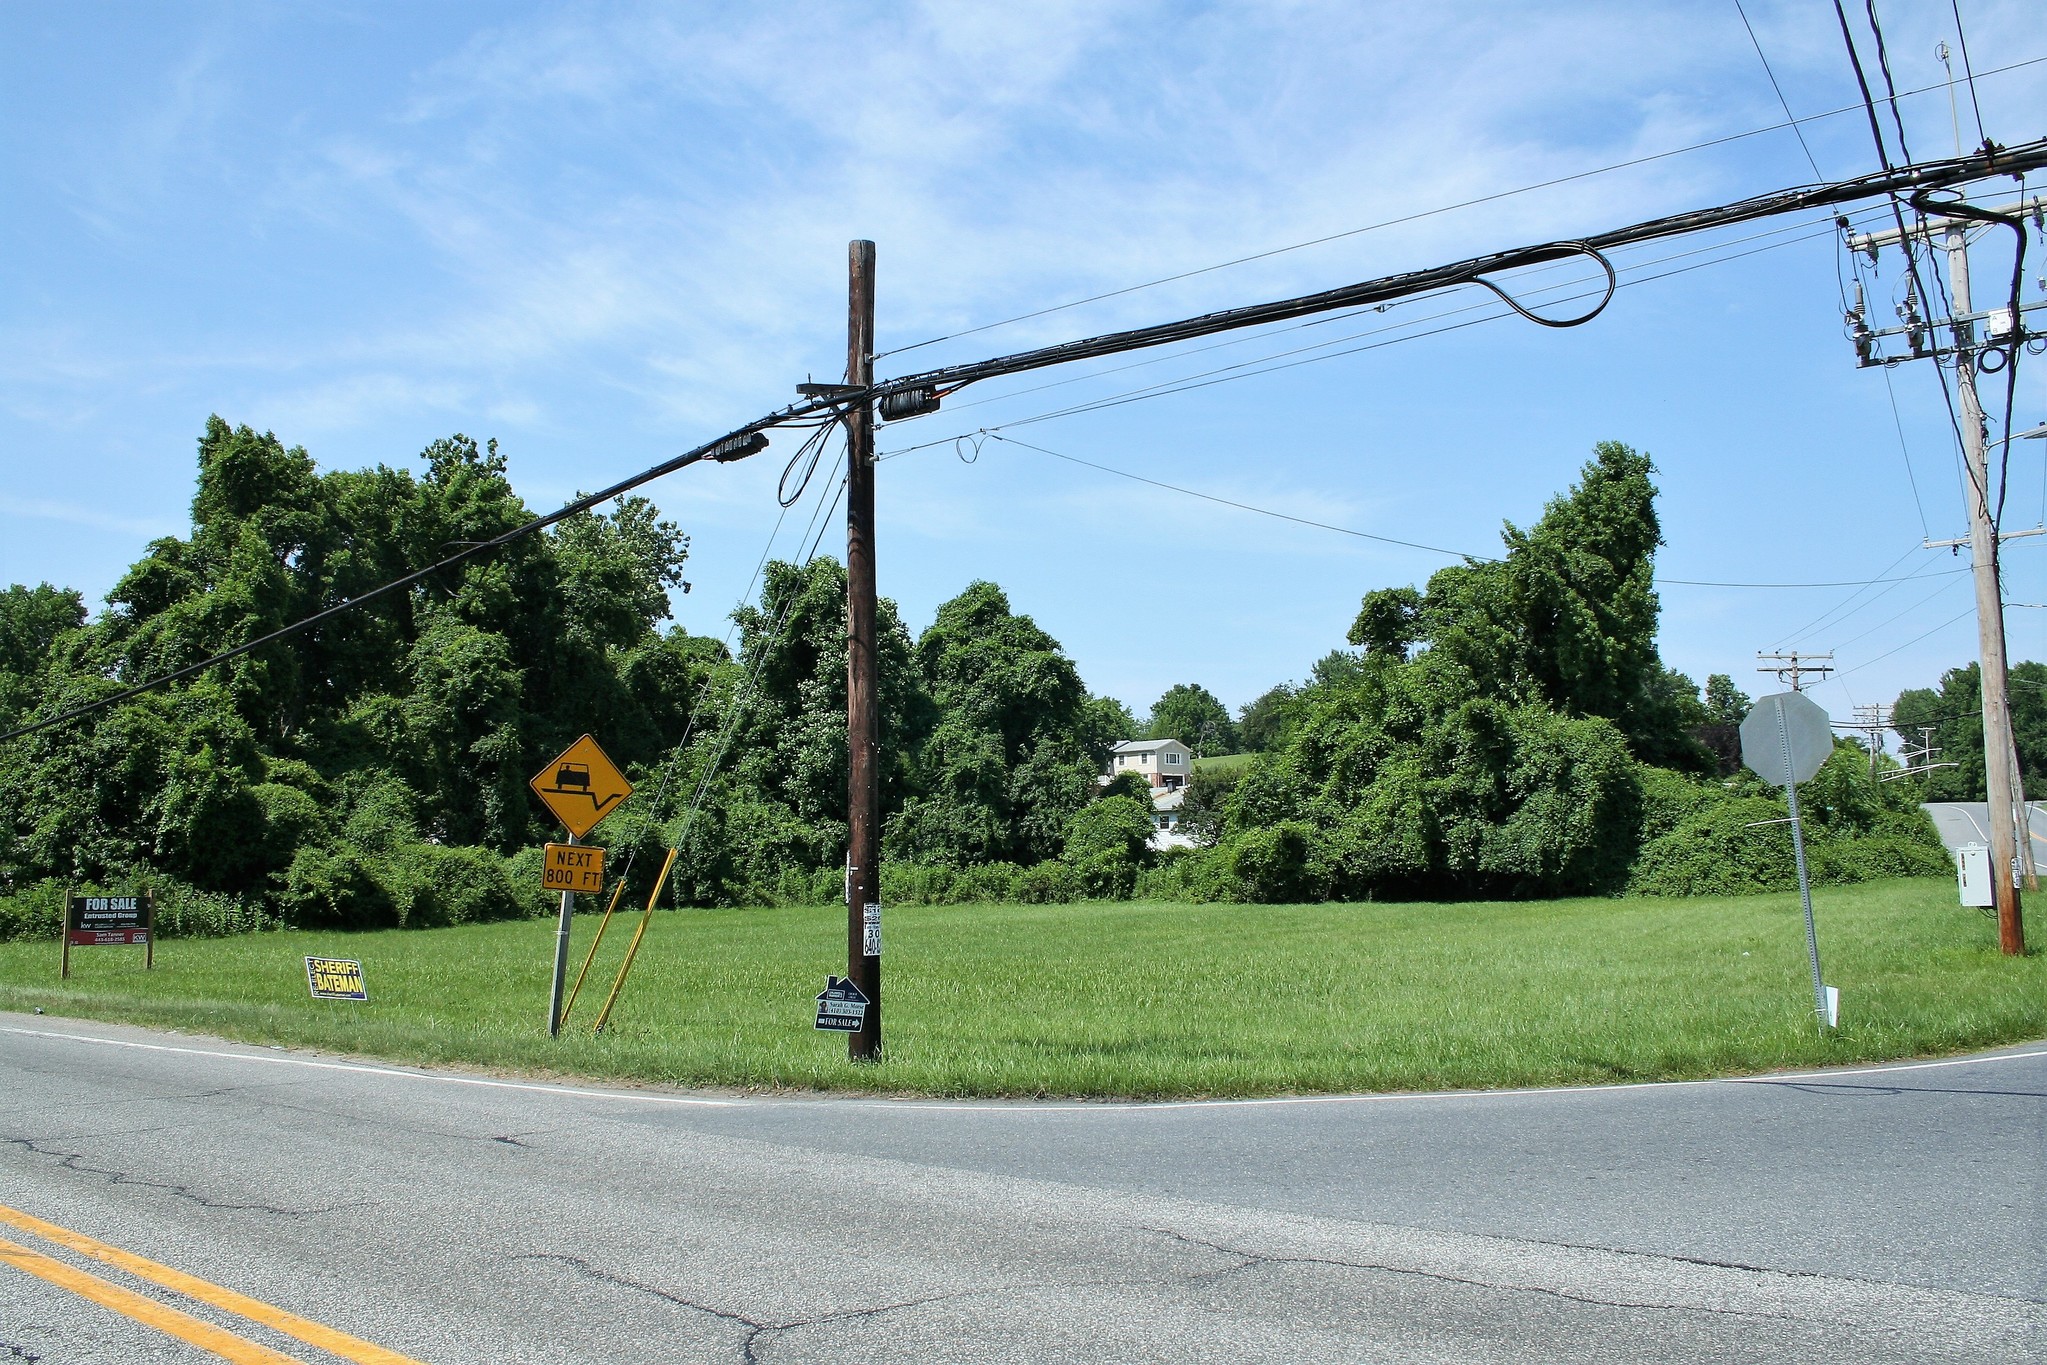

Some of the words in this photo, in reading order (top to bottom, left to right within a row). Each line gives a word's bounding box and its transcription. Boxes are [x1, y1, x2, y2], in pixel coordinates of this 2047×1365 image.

[557, 851, 592, 867] NEXT
[547, 869, 573, 884] 800
[582, 872, 600, 886] FT
[86, 899, 108, 910] FOR
[110, 898, 136, 910] SALE
[314, 960, 358, 974] SHERIFF
[316, 973, 363, 992] BATEMAN
[825, 1018, 837, 1026] FOR
[837, 1019, 852, 1027] SALE
